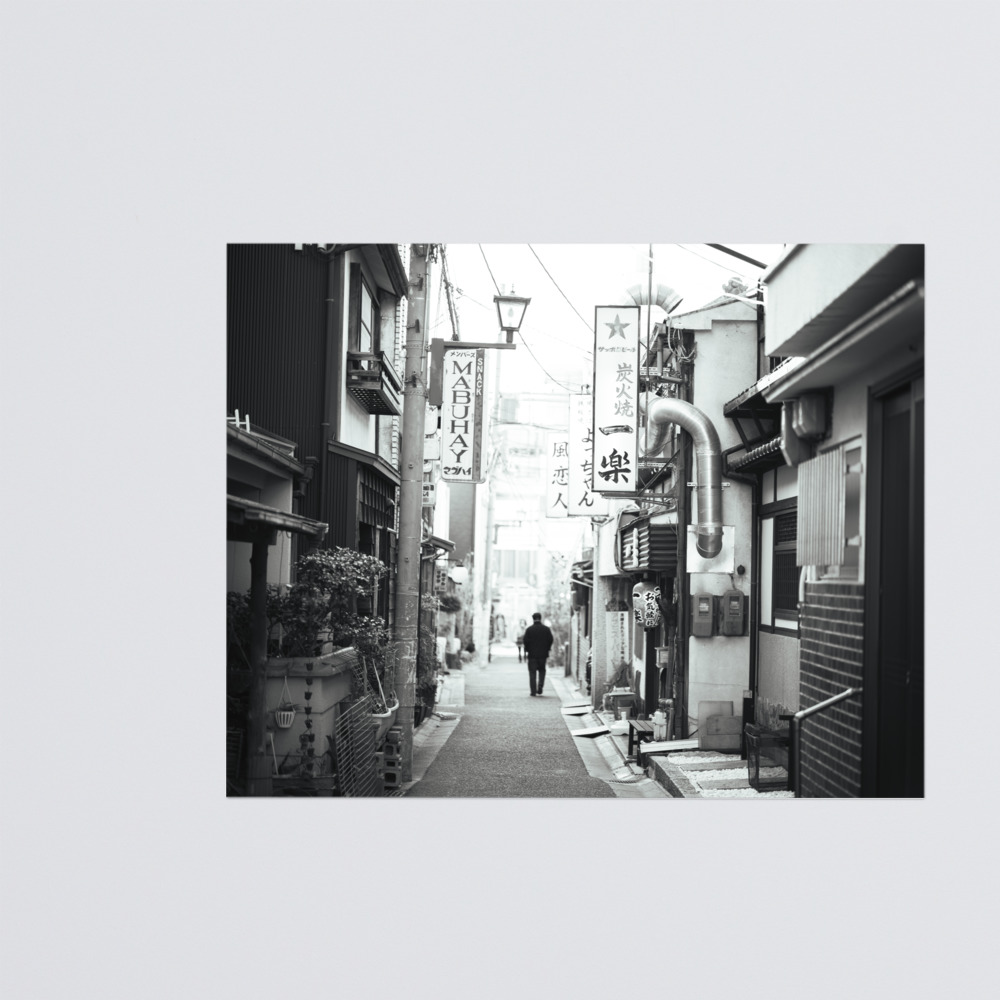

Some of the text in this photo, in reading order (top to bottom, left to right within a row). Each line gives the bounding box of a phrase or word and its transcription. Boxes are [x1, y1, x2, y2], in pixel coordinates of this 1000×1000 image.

[476, 357, 484, 396] SNACK
[614, 362, 634, 418] 炭火焼
[449, 360, 472, 464] MABUHAY
[598, 424, 634, 484] 一楽
